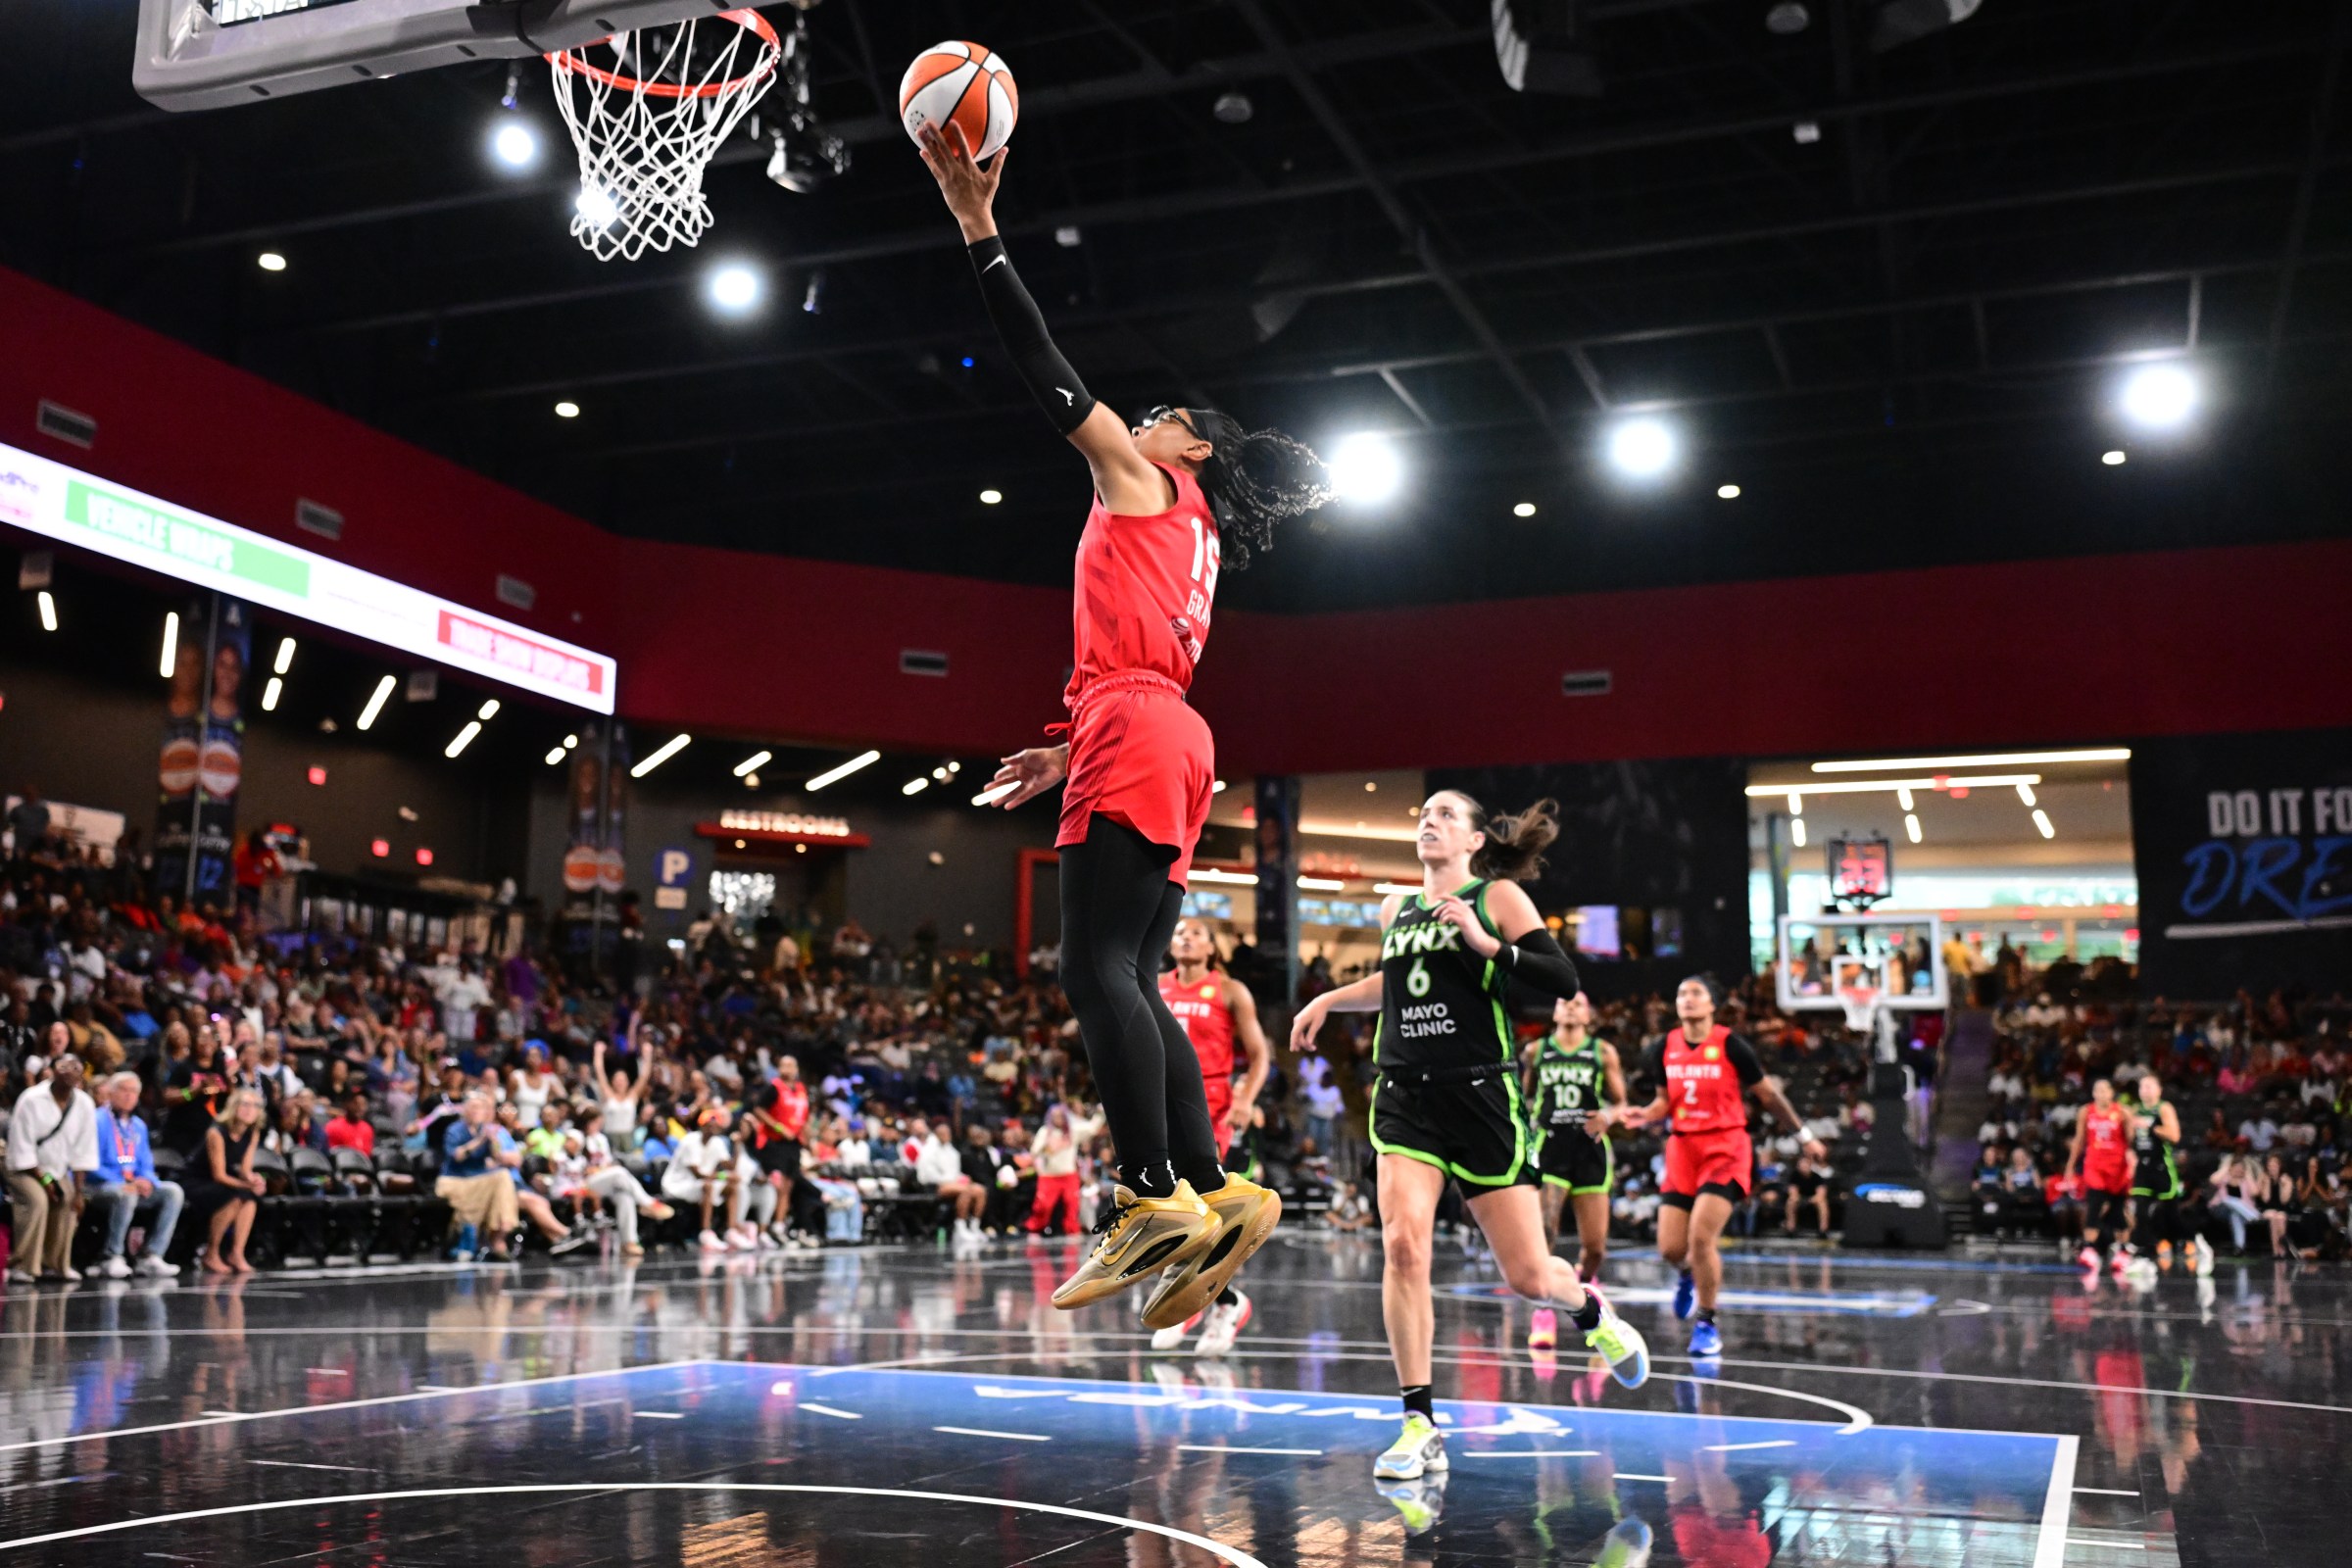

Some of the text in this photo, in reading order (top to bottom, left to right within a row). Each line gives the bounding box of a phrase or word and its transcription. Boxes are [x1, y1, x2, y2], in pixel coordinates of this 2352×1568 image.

[1190, 516, 1221, 603] 15
[2208, 787, 2352, 836] DO IT FO
[662, 850, 690, 885] P
[2180, 836, 2352, 921] DRE
[1382, 925, 1460, 961] LYNX
[1405, 956, 1431, 998] 6
[1400, 1019, 1456, 1038] CLINIC
[1401, 1003, 1447, 1021] MAYO
[1540, 1065, 1593, 1086] LYNX
[1684, 1079, 1697, 1104] 2
[1553, 1084, 1583, 1108] 10
